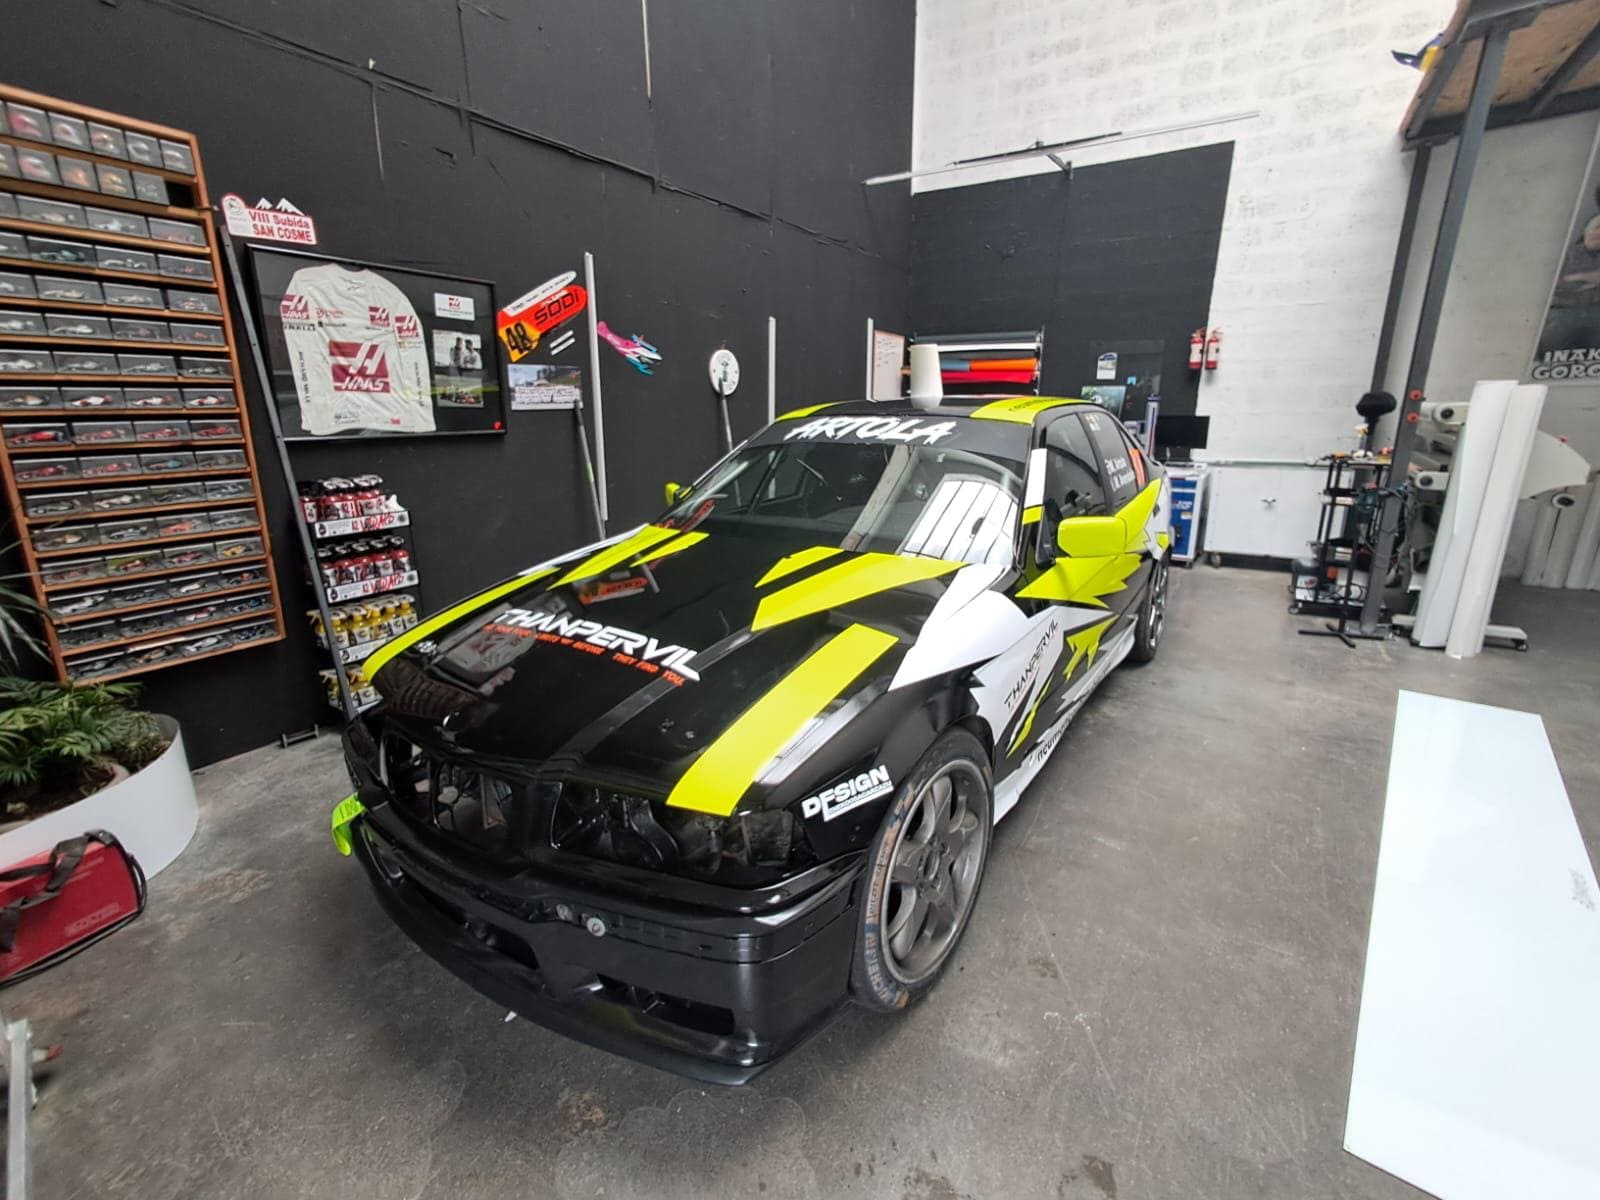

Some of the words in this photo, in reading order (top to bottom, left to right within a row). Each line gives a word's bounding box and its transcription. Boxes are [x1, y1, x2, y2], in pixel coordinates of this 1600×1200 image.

[249, 211, 270, 223] VIII
[272, 214, 310, 229] Subida
[252, 224, 275, 237] SAN
[277, 228, 313, 242] COSME
[534, 288, 580, 327] SODI
[505, 322, 532, 354] 48
[783, 416, 957, 445] ARTOLA
[494, 608, 701, 683] THANPERVIL
[1004, 618, 1060, 709] THANPERVIL
